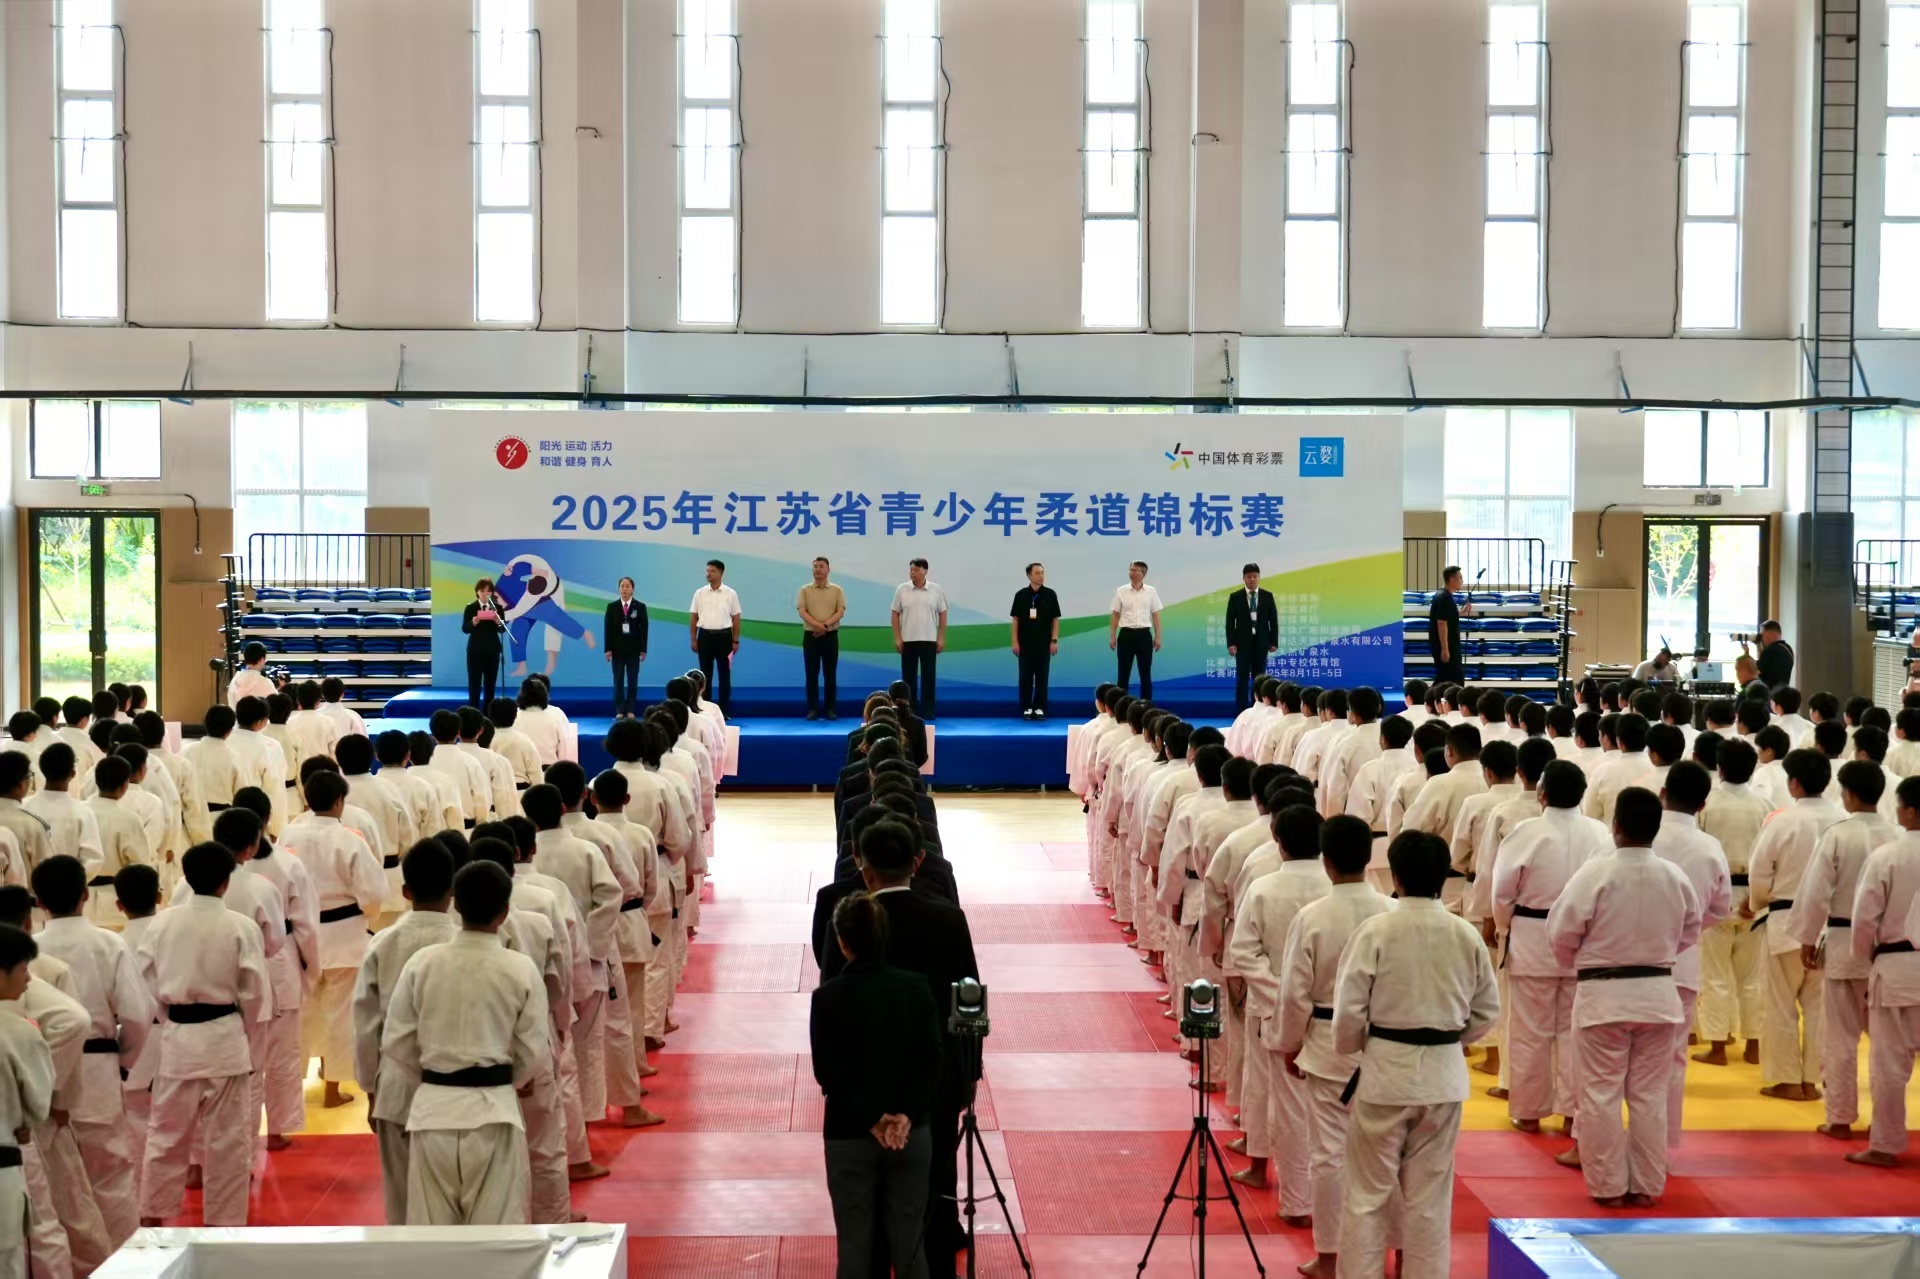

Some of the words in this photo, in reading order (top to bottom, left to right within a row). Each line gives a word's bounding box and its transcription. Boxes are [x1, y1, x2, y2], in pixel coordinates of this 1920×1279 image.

[539, 440, 562, 452] 阳光
[565, 440, 587, 452] 运动
[590, 440, 613, 452] 活力
[539, 456, 562, 467] 和谐
[565, 456, 587, 467] 健身
[590, 456, 613, 467] 育人
[1198, 451, 1284, 465] 中国体育彩票
[551, 490, 1285, 538] 2025年江苏省青少年柔道锦标赛
